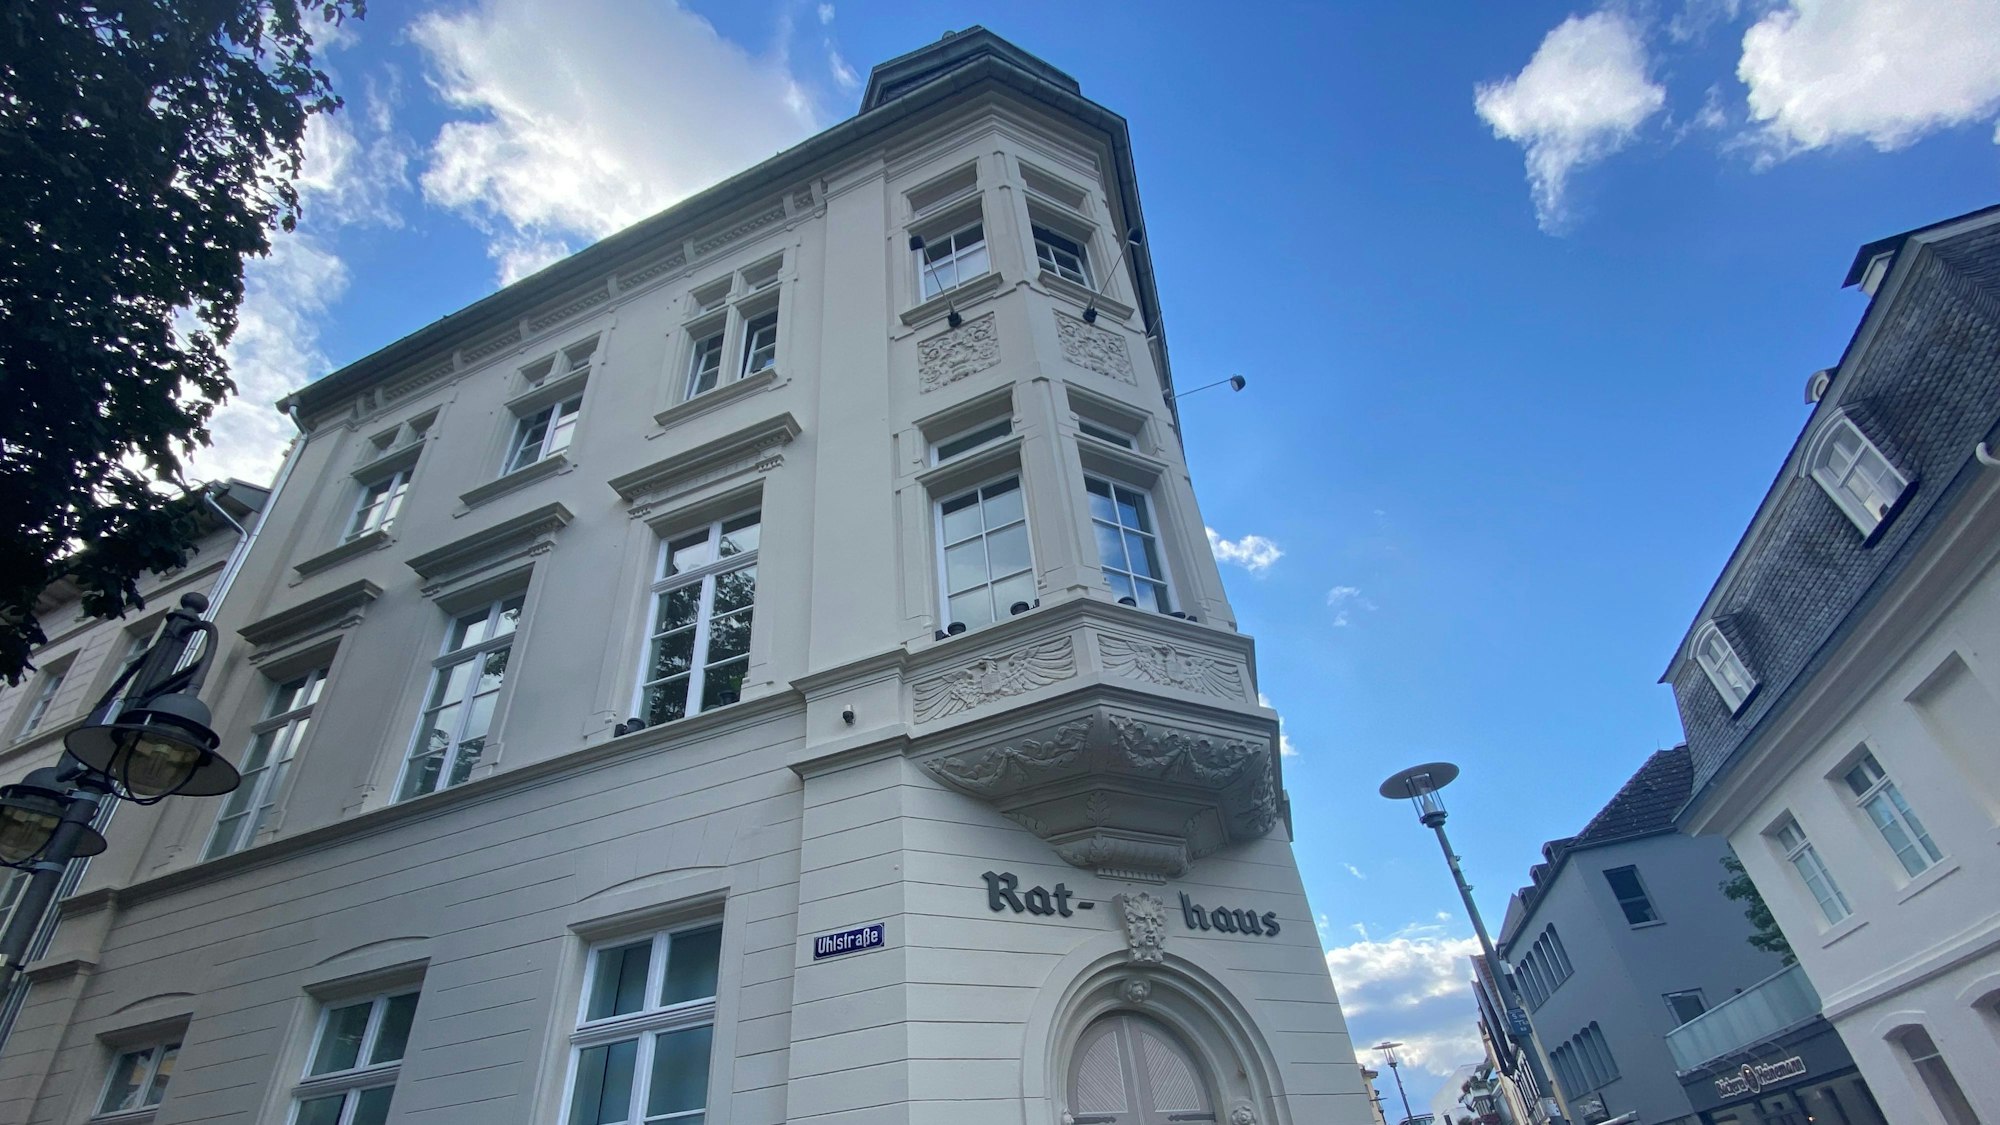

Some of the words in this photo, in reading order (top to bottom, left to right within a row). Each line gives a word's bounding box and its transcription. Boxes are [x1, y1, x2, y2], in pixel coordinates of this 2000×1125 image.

[981, 870, 1095, 917] Rat-
[1178, 890, 1281, 937] haus
[817, 928, 879, 954] Uhlstraße
